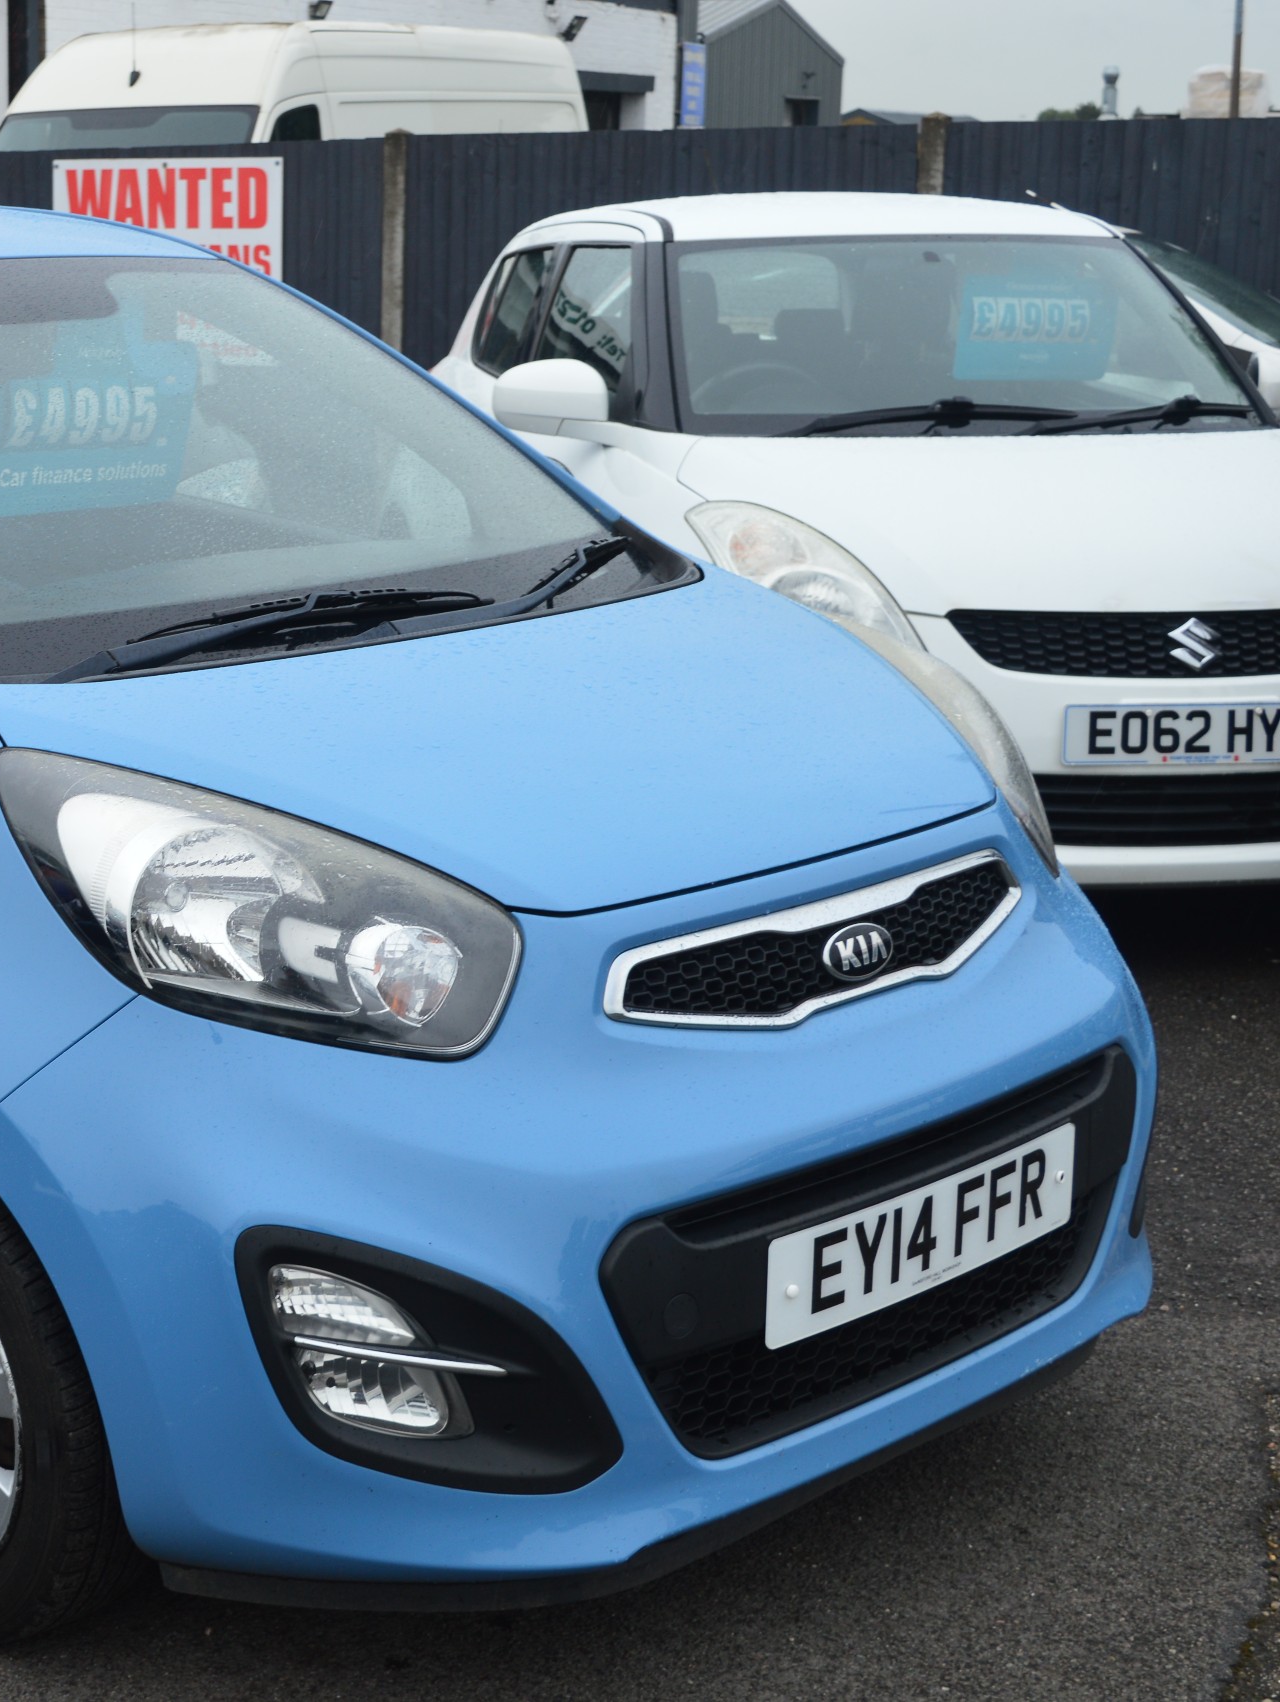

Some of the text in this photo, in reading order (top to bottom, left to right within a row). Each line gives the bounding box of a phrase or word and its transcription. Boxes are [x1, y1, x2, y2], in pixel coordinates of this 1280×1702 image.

[66, 168, 268, 229] WANTED
[973, 300, 1088, 339] £4995
[8, 386, 157, 447] £4995
[0, 460, 167, 487] Car finance solutions
[835, 931, 888, 971] KIA
[811, 1148, 1046, 1315] EY14 FFR
